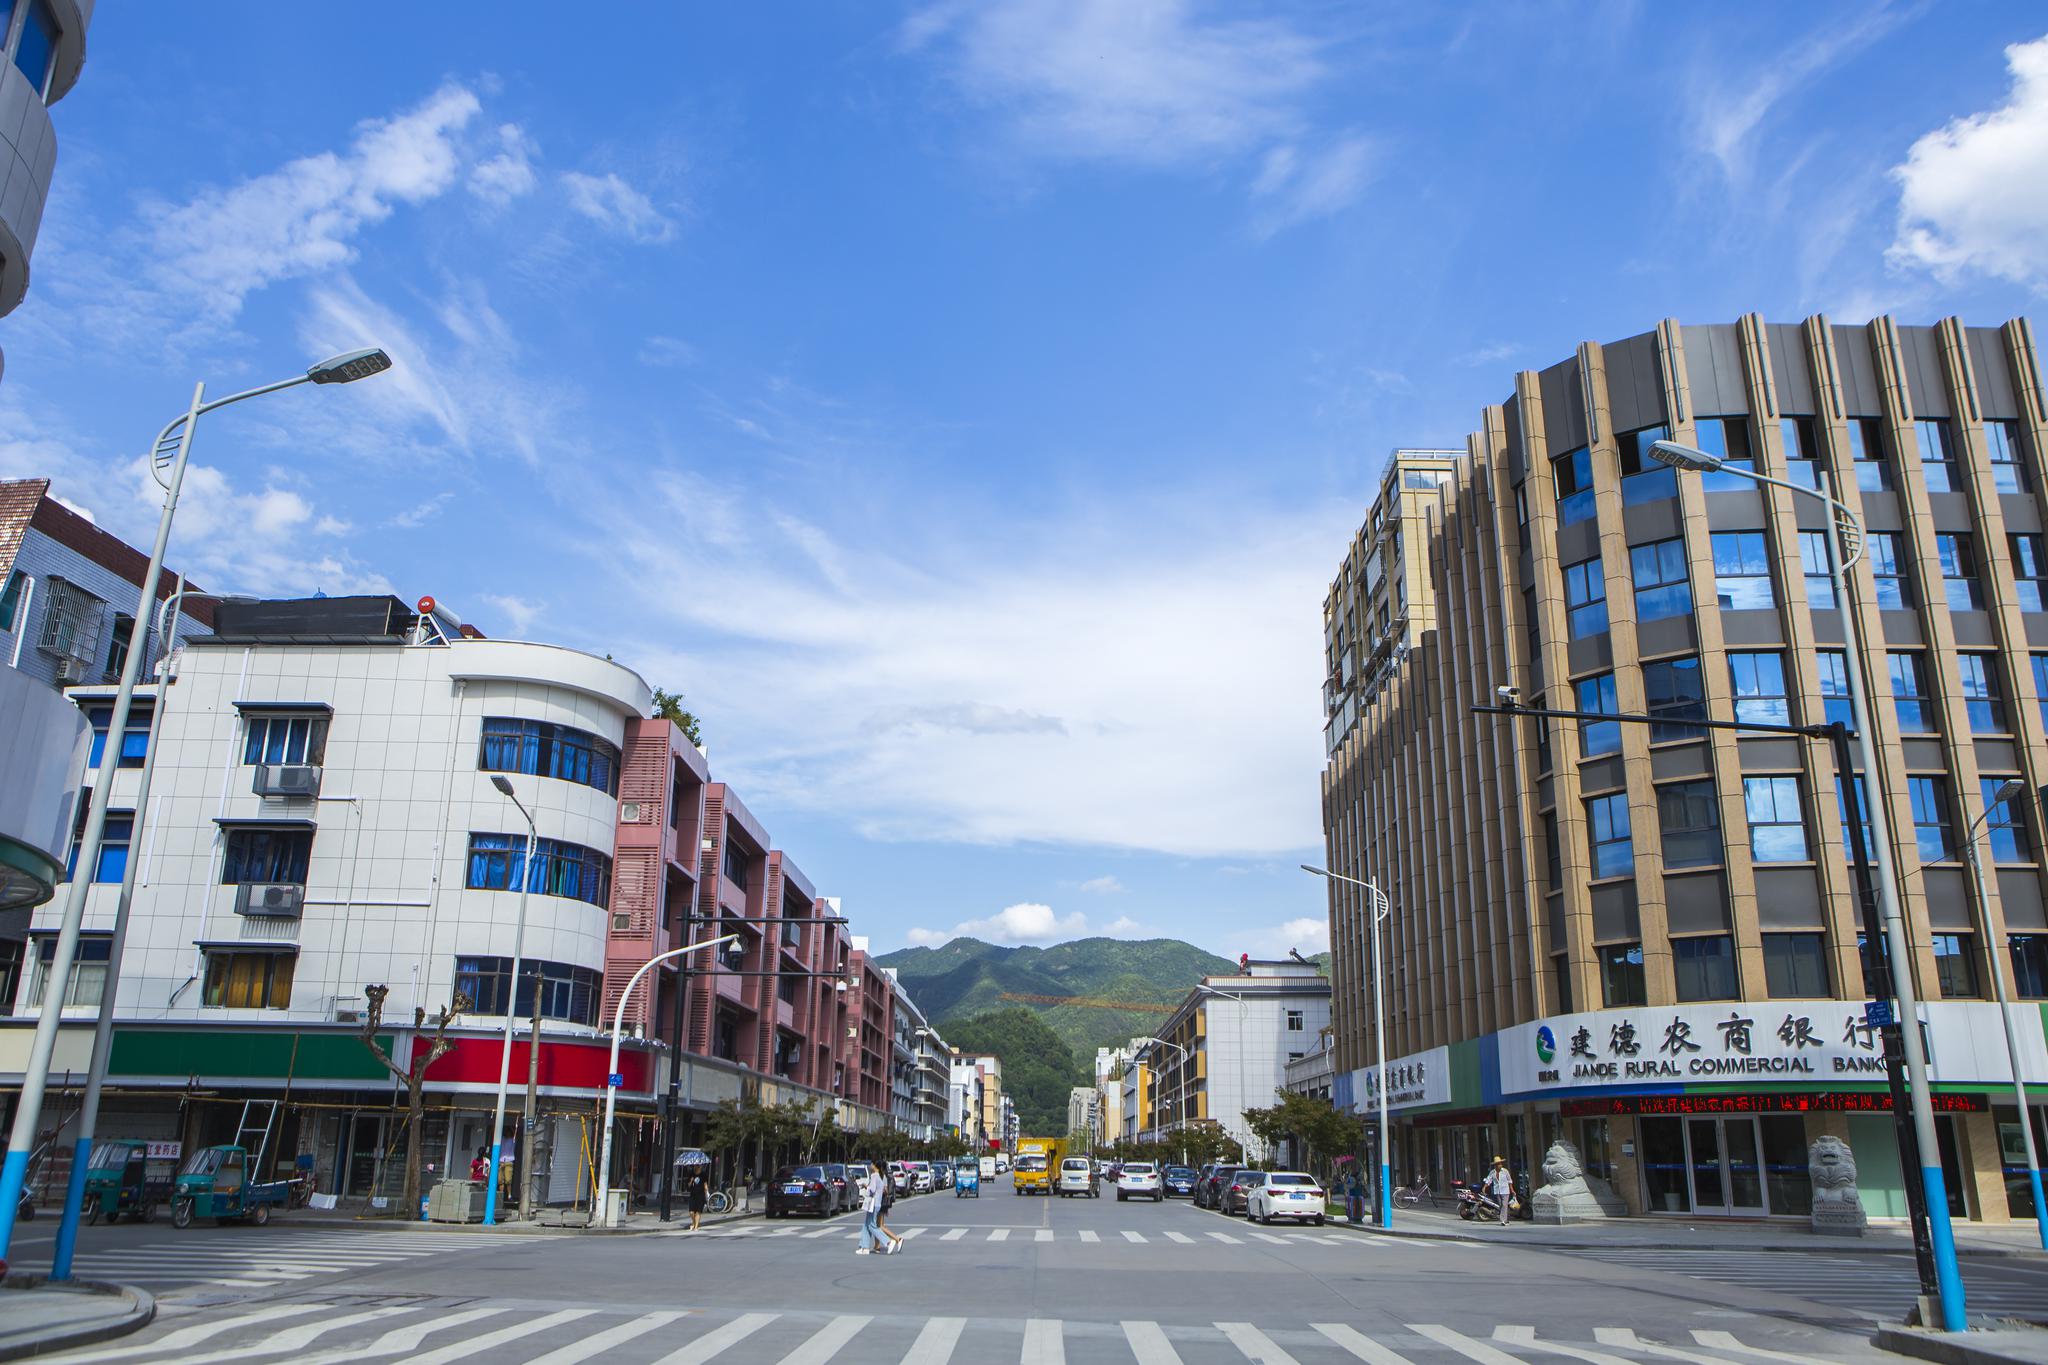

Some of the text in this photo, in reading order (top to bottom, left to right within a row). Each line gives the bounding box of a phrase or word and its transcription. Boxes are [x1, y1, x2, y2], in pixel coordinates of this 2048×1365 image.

[1570, 1011, 1879, 1059] 建德农商银行
[1572, 1062, 1618, 1078] JIANDE
[1625, 1060, 1681, 1076] RURAL
[1689, 1057, 1815, 1075] COMMERCIAL
[1832, 1057, 1883, 1073] BANK
